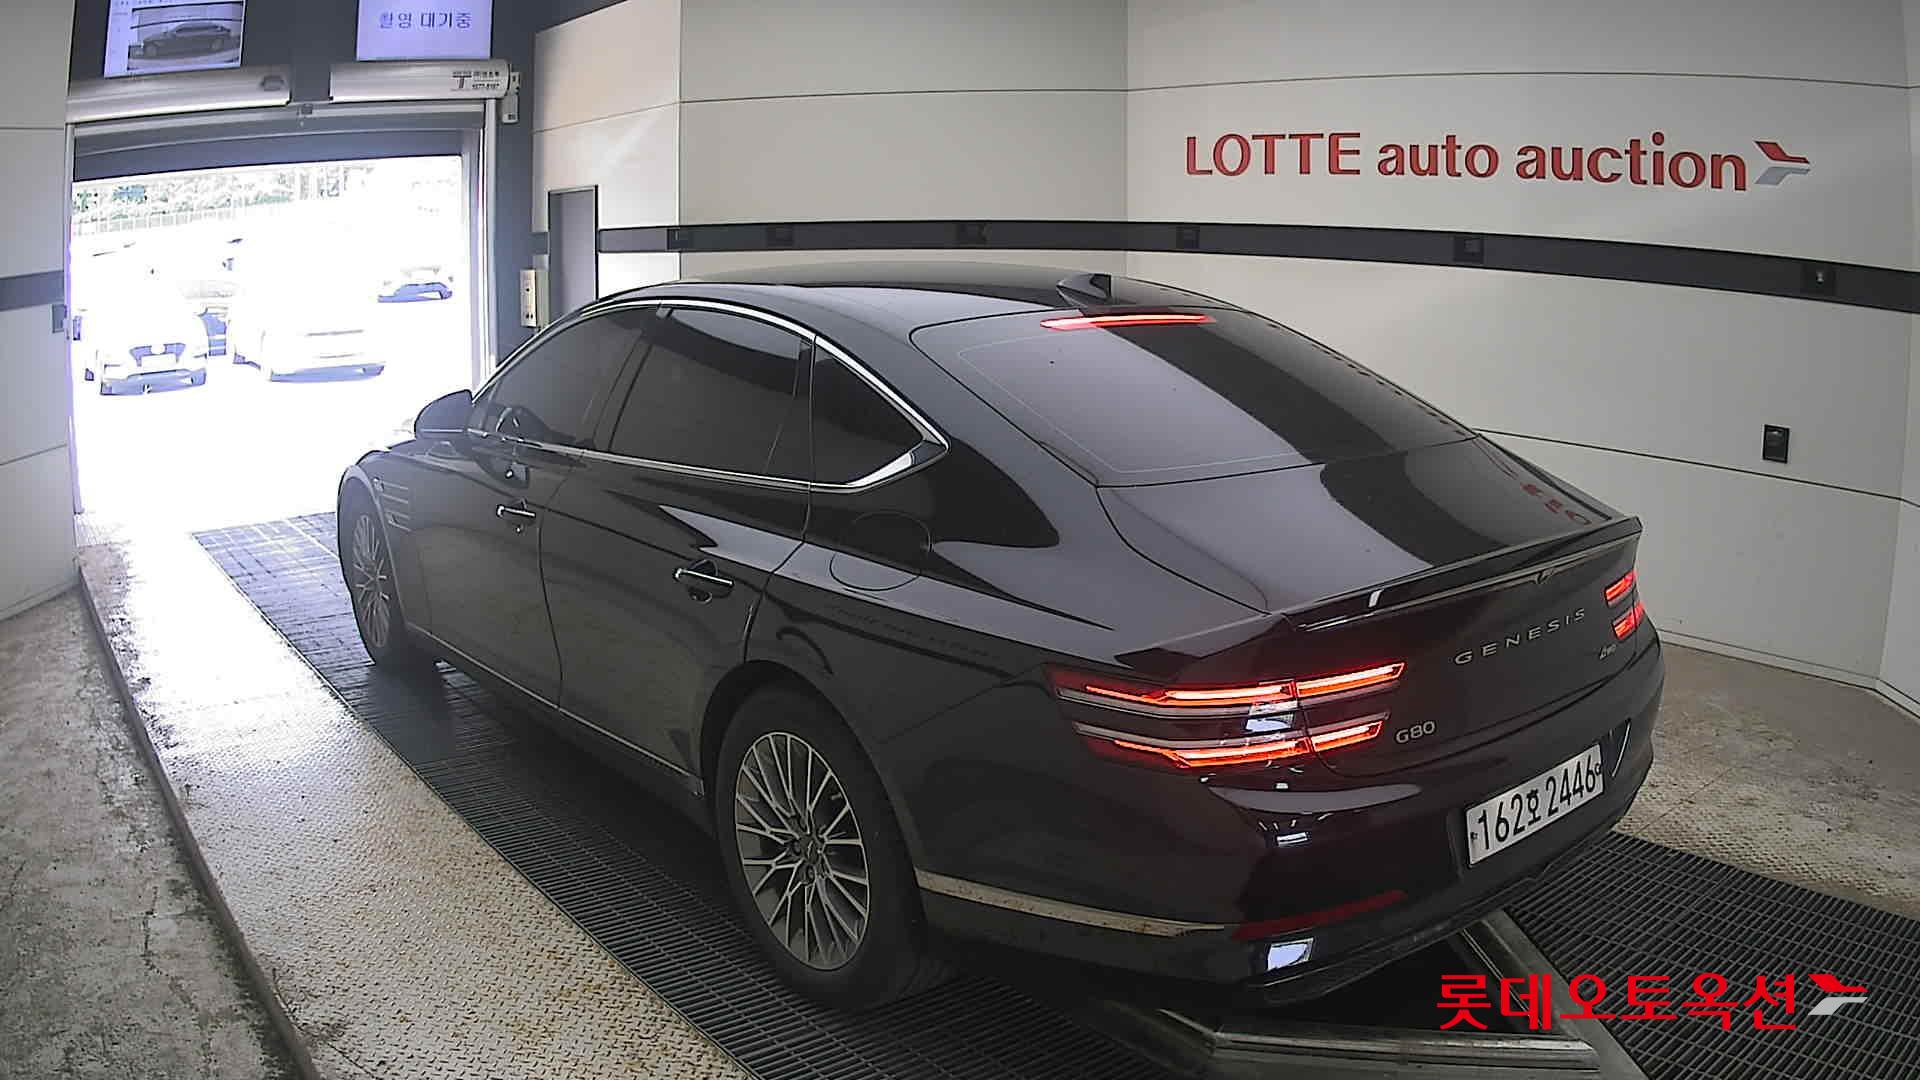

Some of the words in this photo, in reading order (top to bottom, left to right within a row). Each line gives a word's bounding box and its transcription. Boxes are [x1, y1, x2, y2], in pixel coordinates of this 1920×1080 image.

[420, 12, 472, 29] 대기중
[1186, 132, 1361, 176] LOTTE
[1378, 134, 1500, 178] auto
[1516, 131, 1747, 191] auction
[1454, 607, 1587, 666] GENESIS
[1395, 720, 1437, 744] G80
